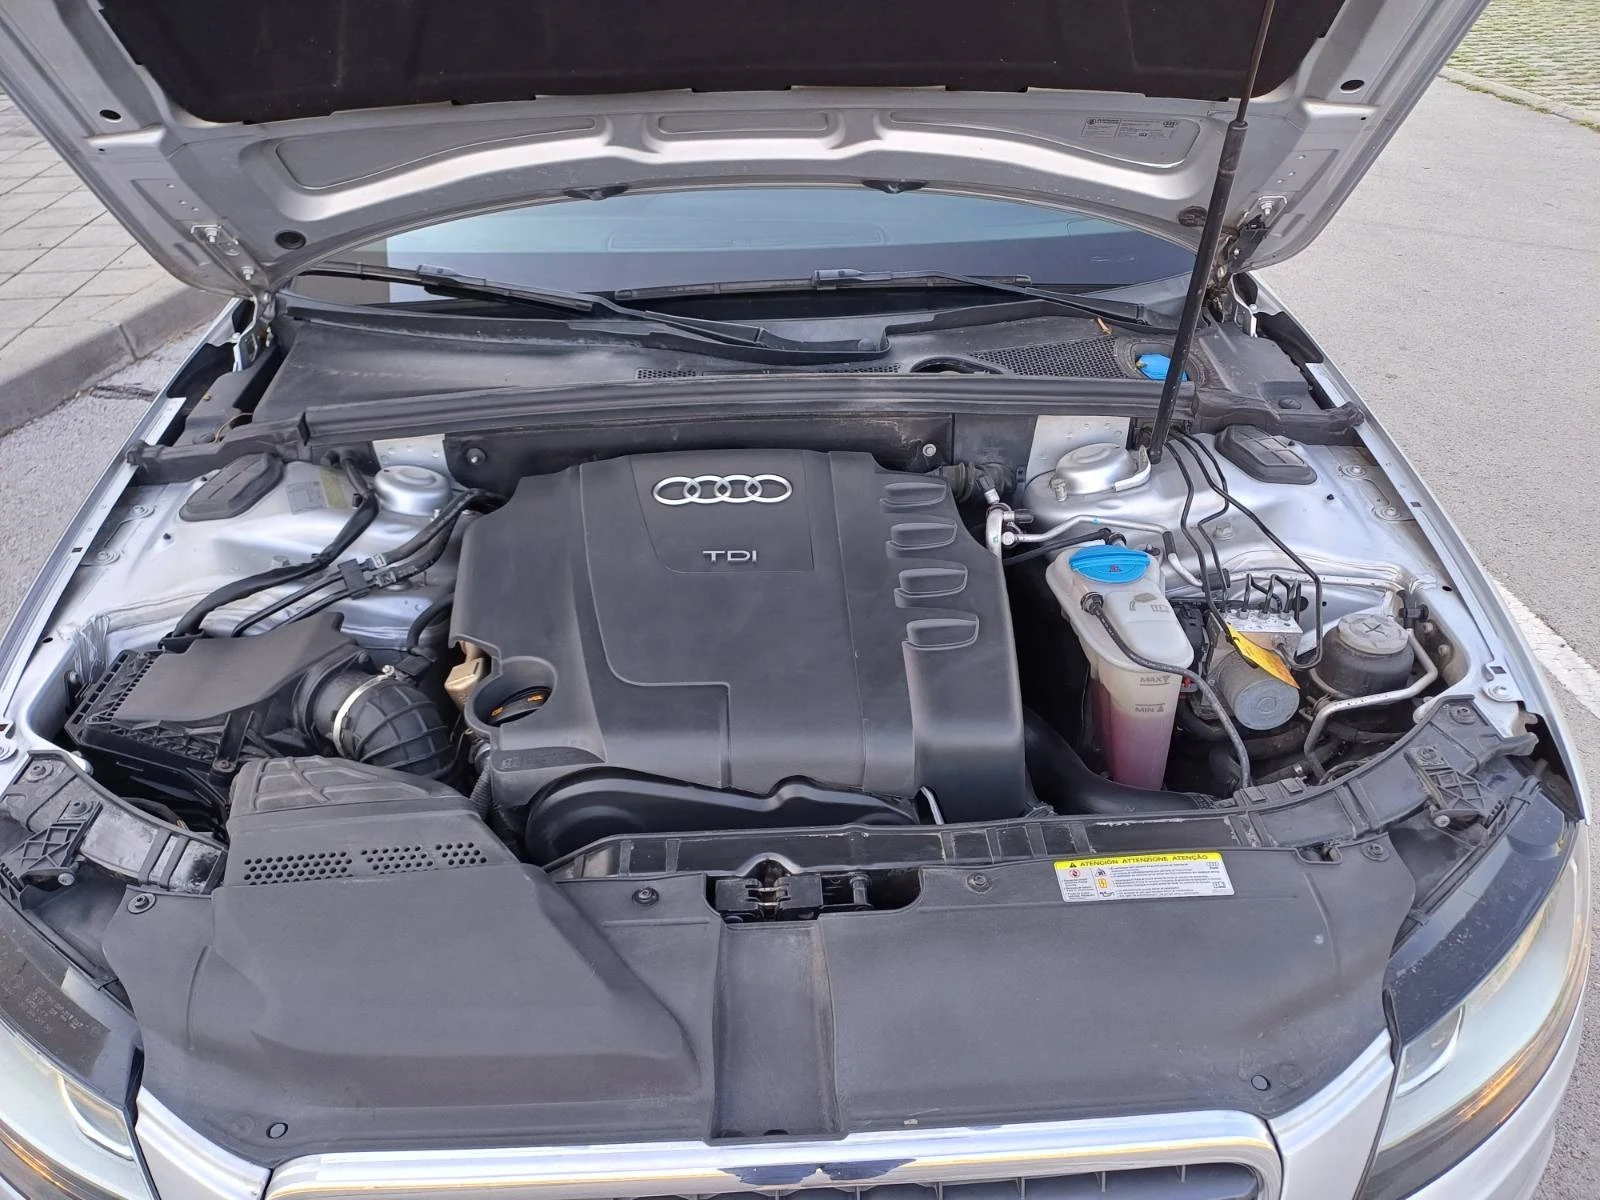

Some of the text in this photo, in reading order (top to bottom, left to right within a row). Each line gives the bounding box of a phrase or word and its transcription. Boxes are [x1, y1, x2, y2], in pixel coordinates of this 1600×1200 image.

[702, 550, 757, 562] TDI
[1080, 853, 1208, 867] ATENCIÓN ATTENZIONE ATENÇÃO
